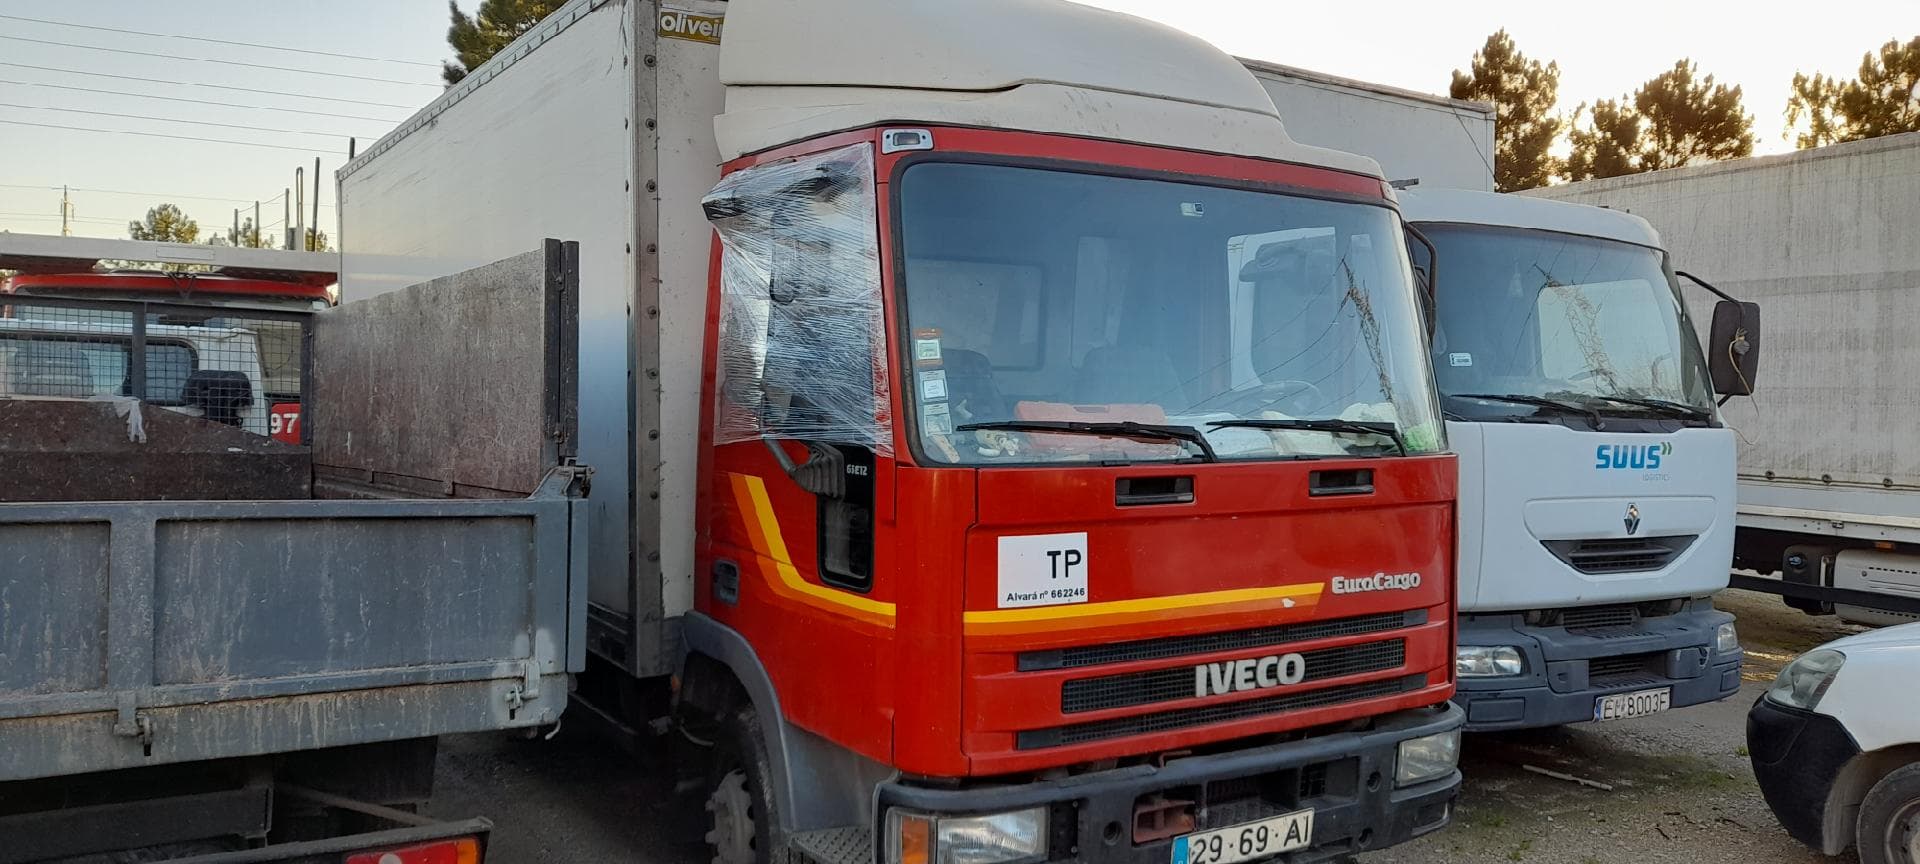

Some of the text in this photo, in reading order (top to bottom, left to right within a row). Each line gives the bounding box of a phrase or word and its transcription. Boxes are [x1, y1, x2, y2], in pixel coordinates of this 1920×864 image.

[270, 413, 298, 434] 97
[1596, 444, 1661, 469] SUUS
[1046, 549, 1082, 579] TP
[1006, 591, 1038, 602] Alvará
[1050, 587, 1086, 599] 662246
[1331, 572, 1421, 594] EuroCargo
[1195, 652, 1306, 697] IVECO
